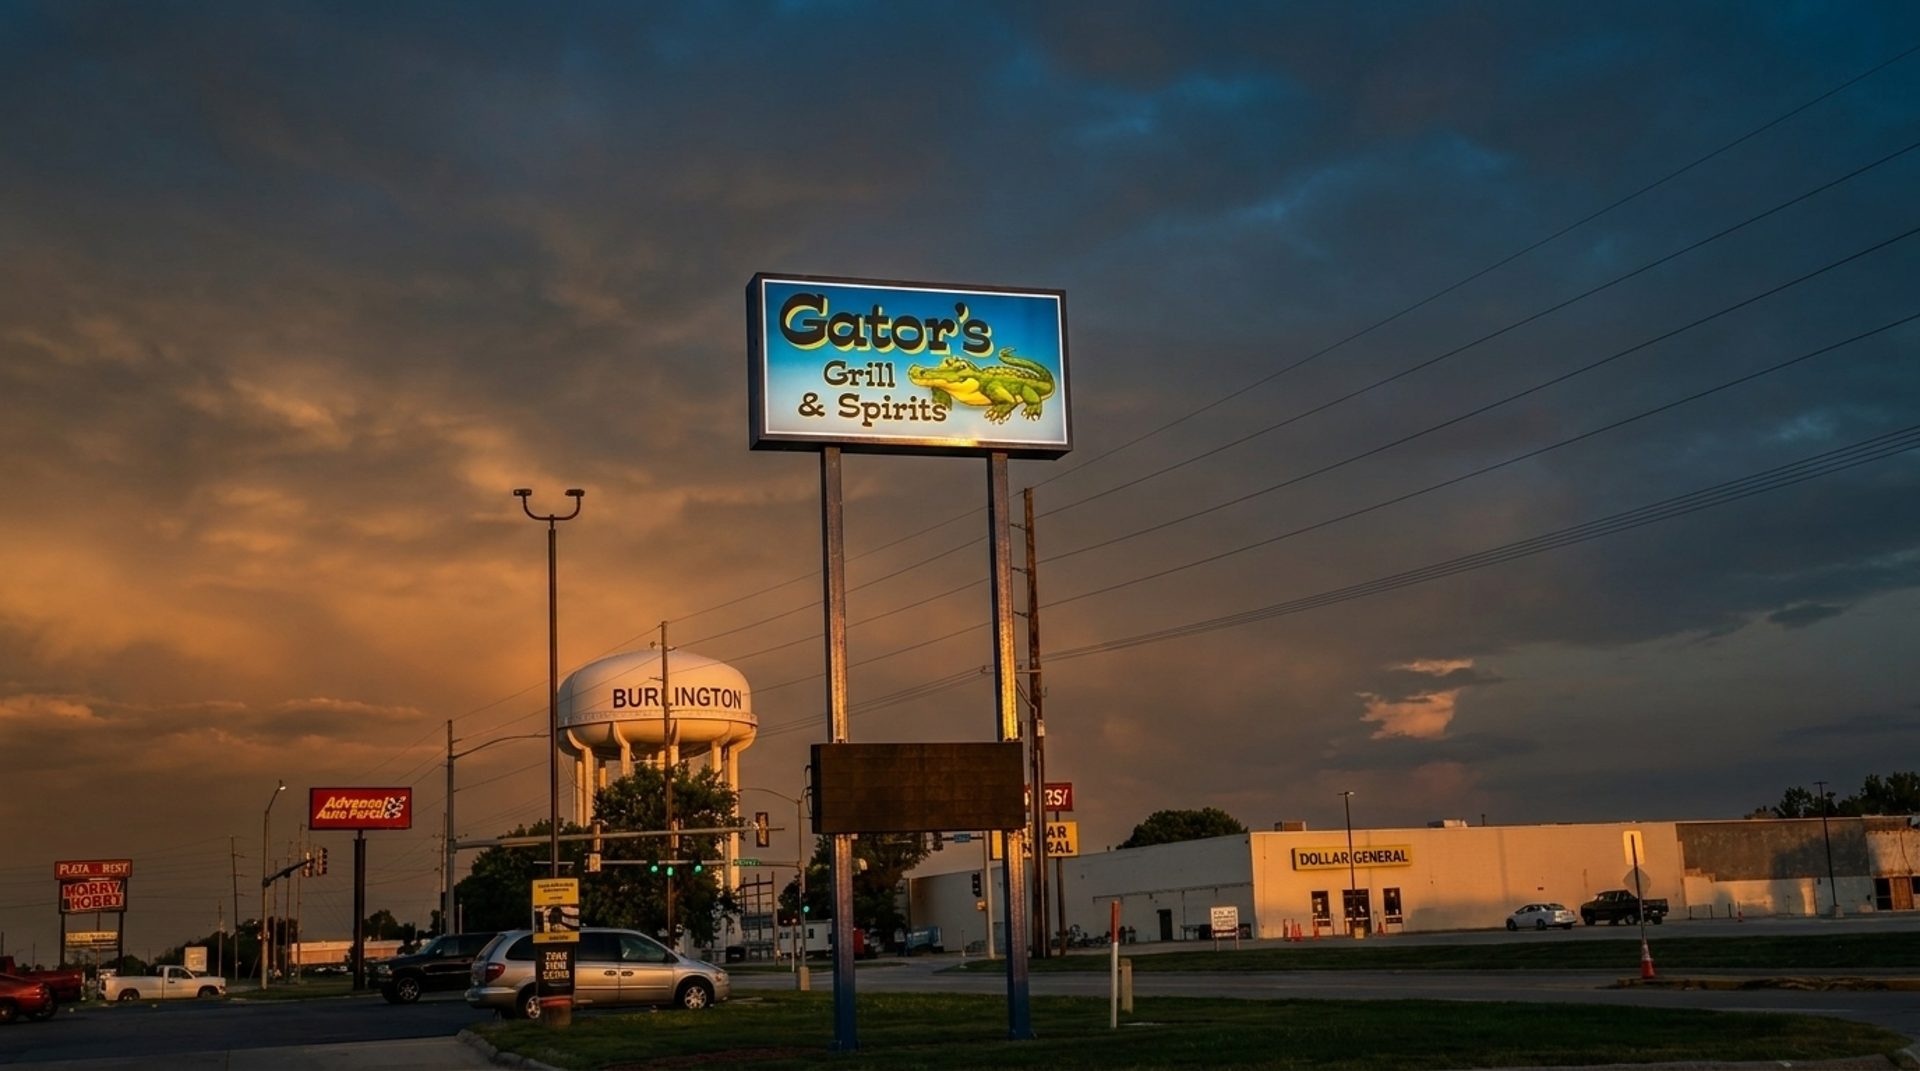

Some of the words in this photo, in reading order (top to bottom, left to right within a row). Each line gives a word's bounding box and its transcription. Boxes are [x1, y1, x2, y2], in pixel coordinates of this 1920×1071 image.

[780, 293, 994, 357] Gator's
[823, 360, 896, 388] Grill
[798, 392, 826, 417] &
[838, 393, 948, 428] Spirits
[1299, 852, 1349, 865] DOLLAR
[1353, 850, 1408, 864] GENERAL
